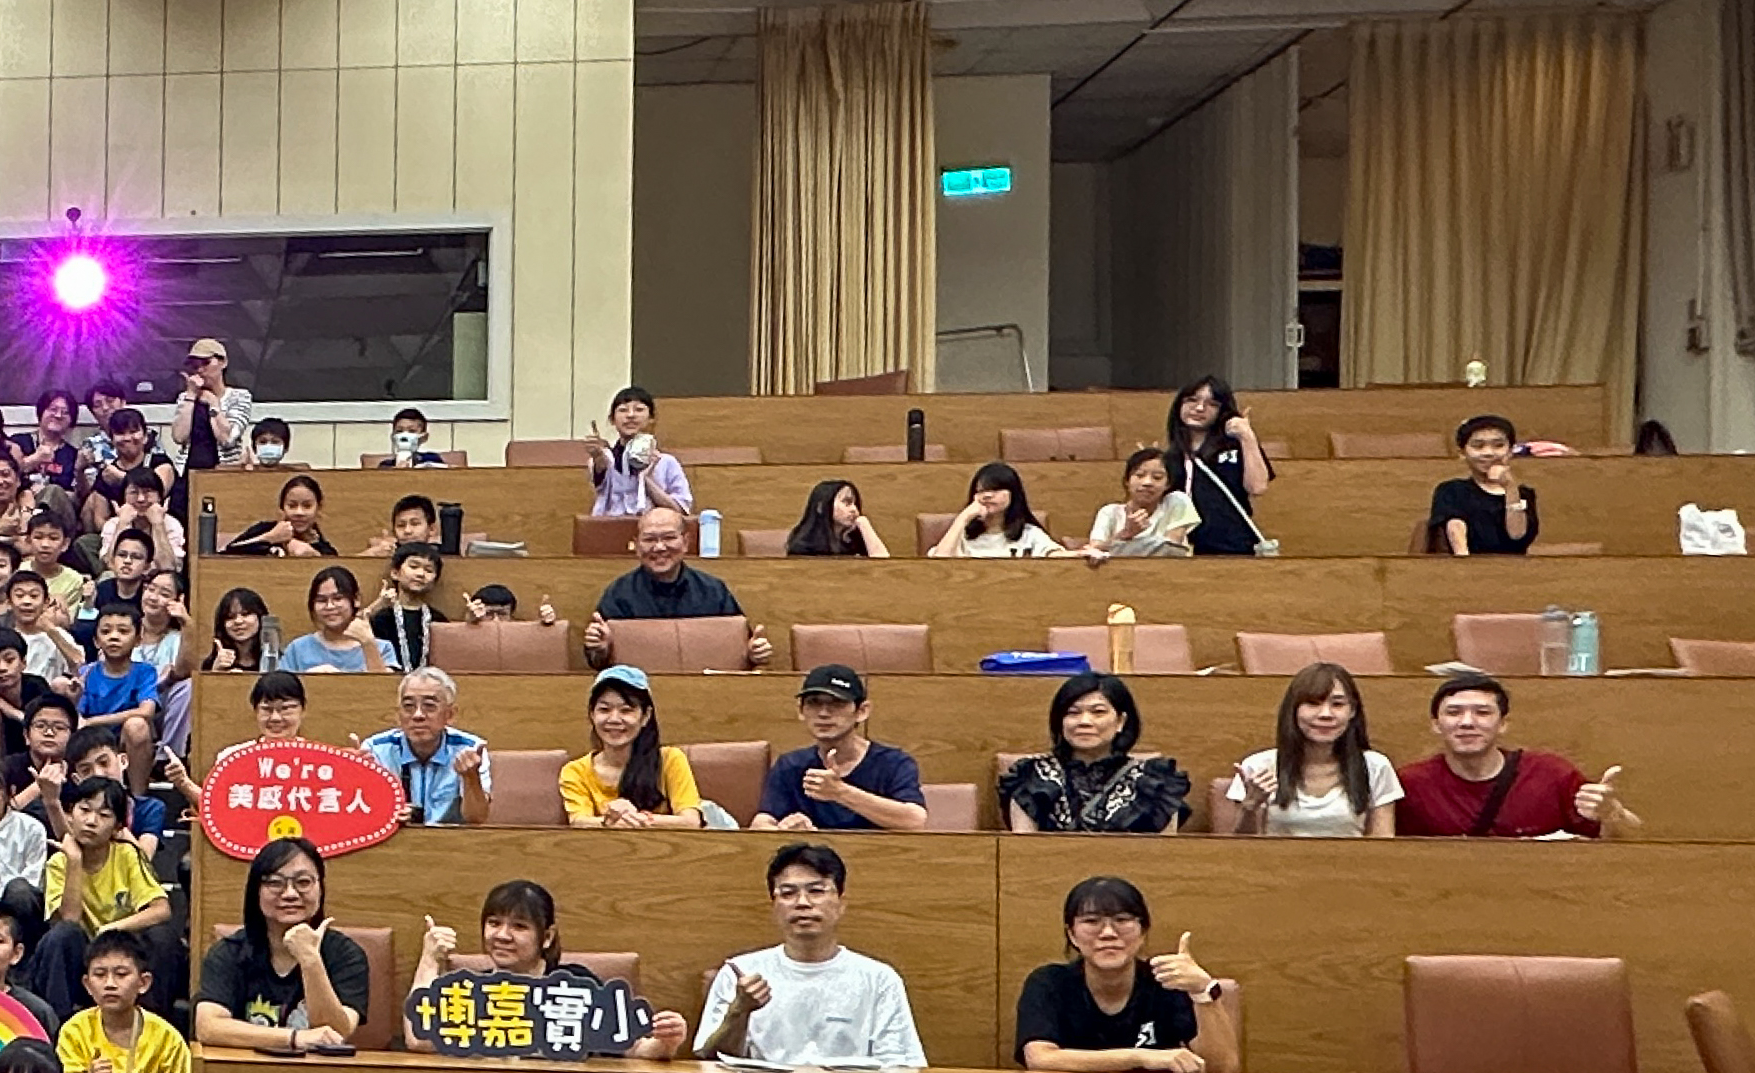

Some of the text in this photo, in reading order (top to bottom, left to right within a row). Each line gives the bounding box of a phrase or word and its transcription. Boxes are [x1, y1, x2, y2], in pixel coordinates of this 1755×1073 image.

[257, 756, 334, 781] We're
[228, 784, 372, 814] 美感代言人
[416, 978, 649, 1052] 博嘉實小
